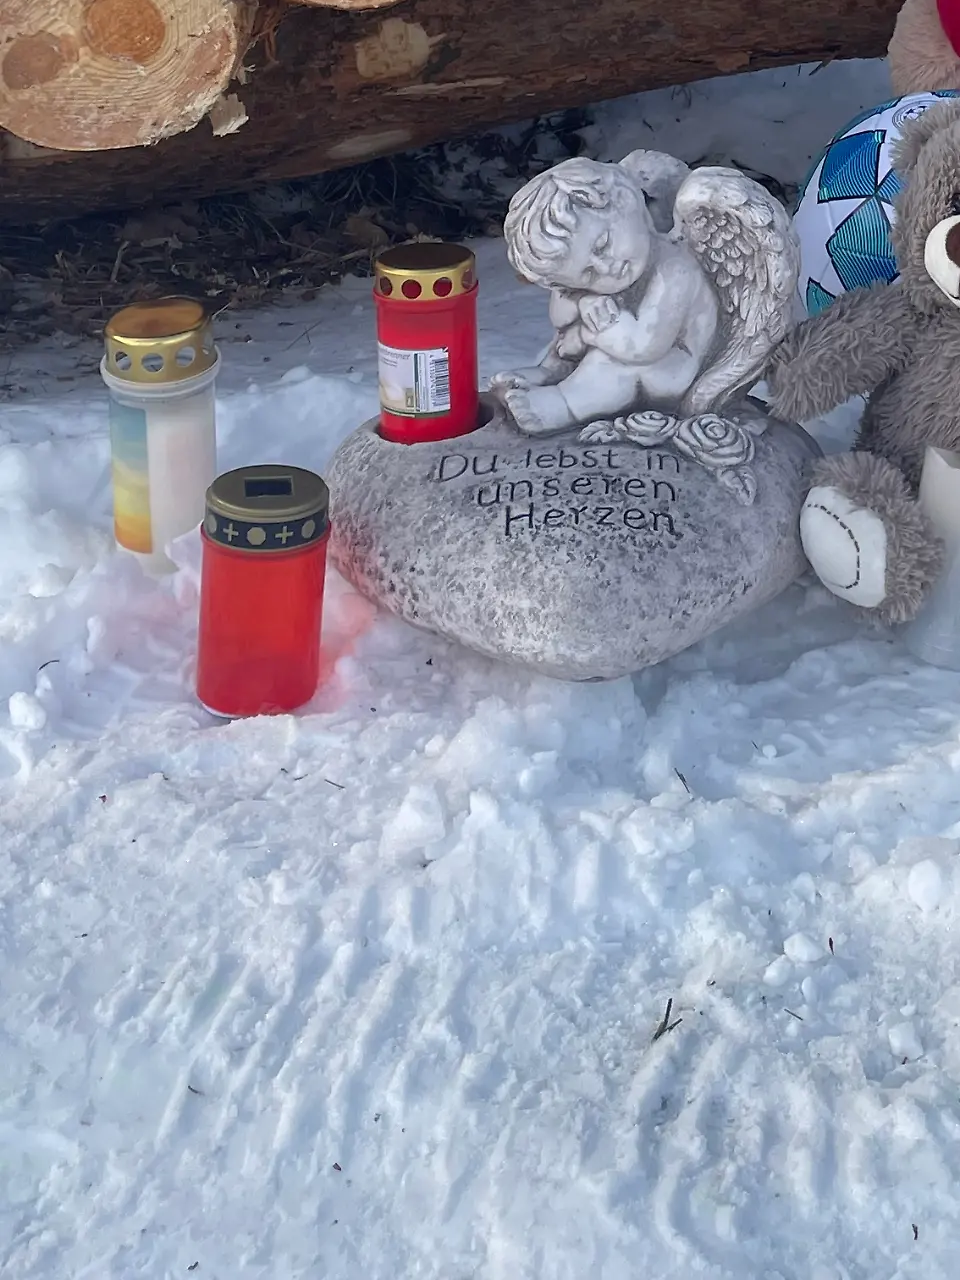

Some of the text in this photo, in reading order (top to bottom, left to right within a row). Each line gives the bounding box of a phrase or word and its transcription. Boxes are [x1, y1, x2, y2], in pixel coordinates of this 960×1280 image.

[438, 448, 681, 482] Du lebst in
[476, 476, 676, 507] unseren
[505, 502, 684, 537] Herzen
